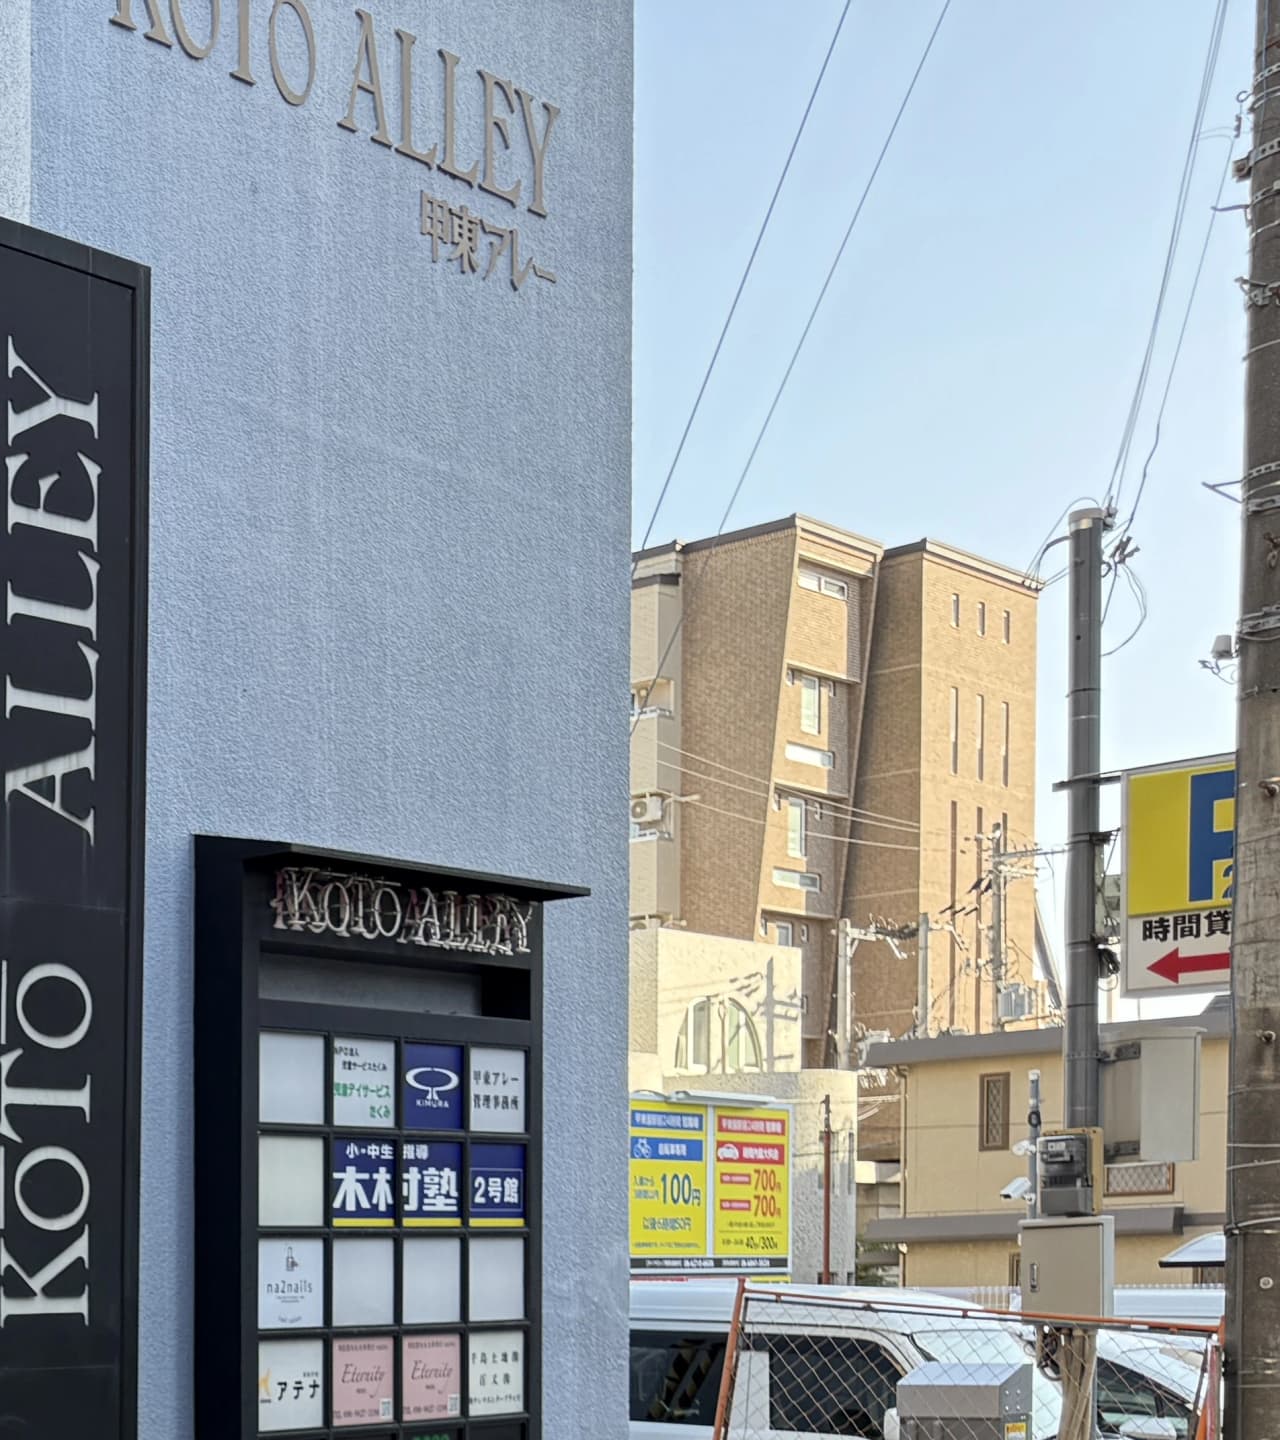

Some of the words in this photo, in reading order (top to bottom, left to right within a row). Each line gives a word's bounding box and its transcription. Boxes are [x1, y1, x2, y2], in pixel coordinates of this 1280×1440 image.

[336, 8, 561, 220] ALLEY
[419, 189, 558, 292] 甲東アレー
[3, 334, 103, 847] ALLEY
[397, 887, 539, 957] ALLEY
[415, 1099, 450, 1109] KIMURA
[473, 1094, 520, 1111] 管理事務所
[473, 1176, 520, 1204] 2号館
[266, 1280, 313, 1294] na2nails
[276, 1379, 320, 1402] アテナ
